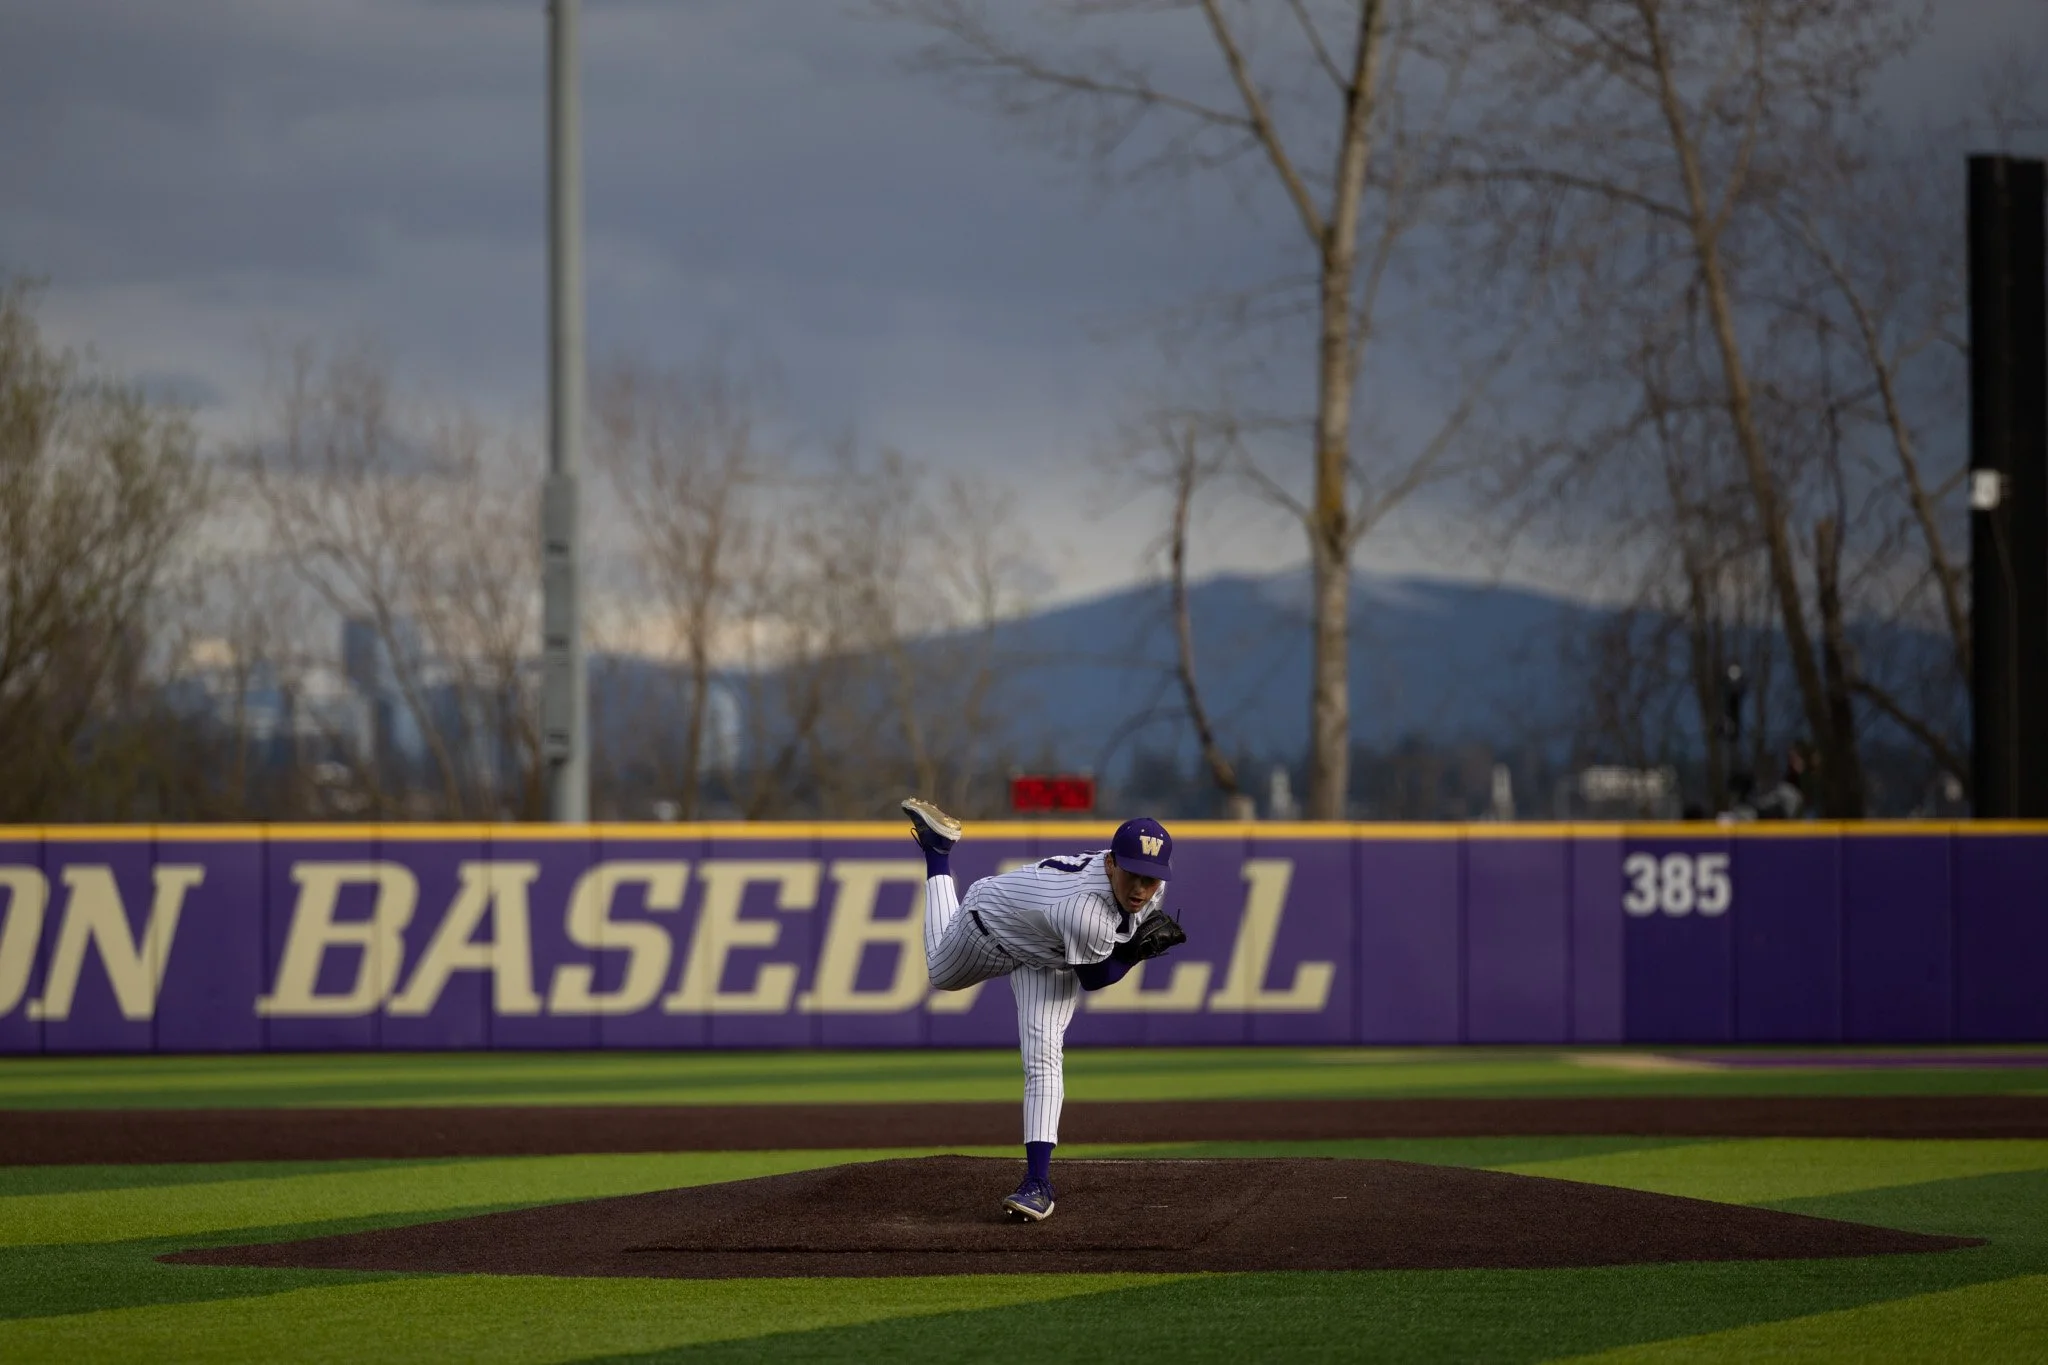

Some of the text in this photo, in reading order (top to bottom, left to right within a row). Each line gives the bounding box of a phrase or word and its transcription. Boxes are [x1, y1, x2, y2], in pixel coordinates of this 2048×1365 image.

[1139, 835, 1164, 857] W
[1622, 852, 1733, 917] 385
[255, 860, 1336, 1016] BASEBLL
